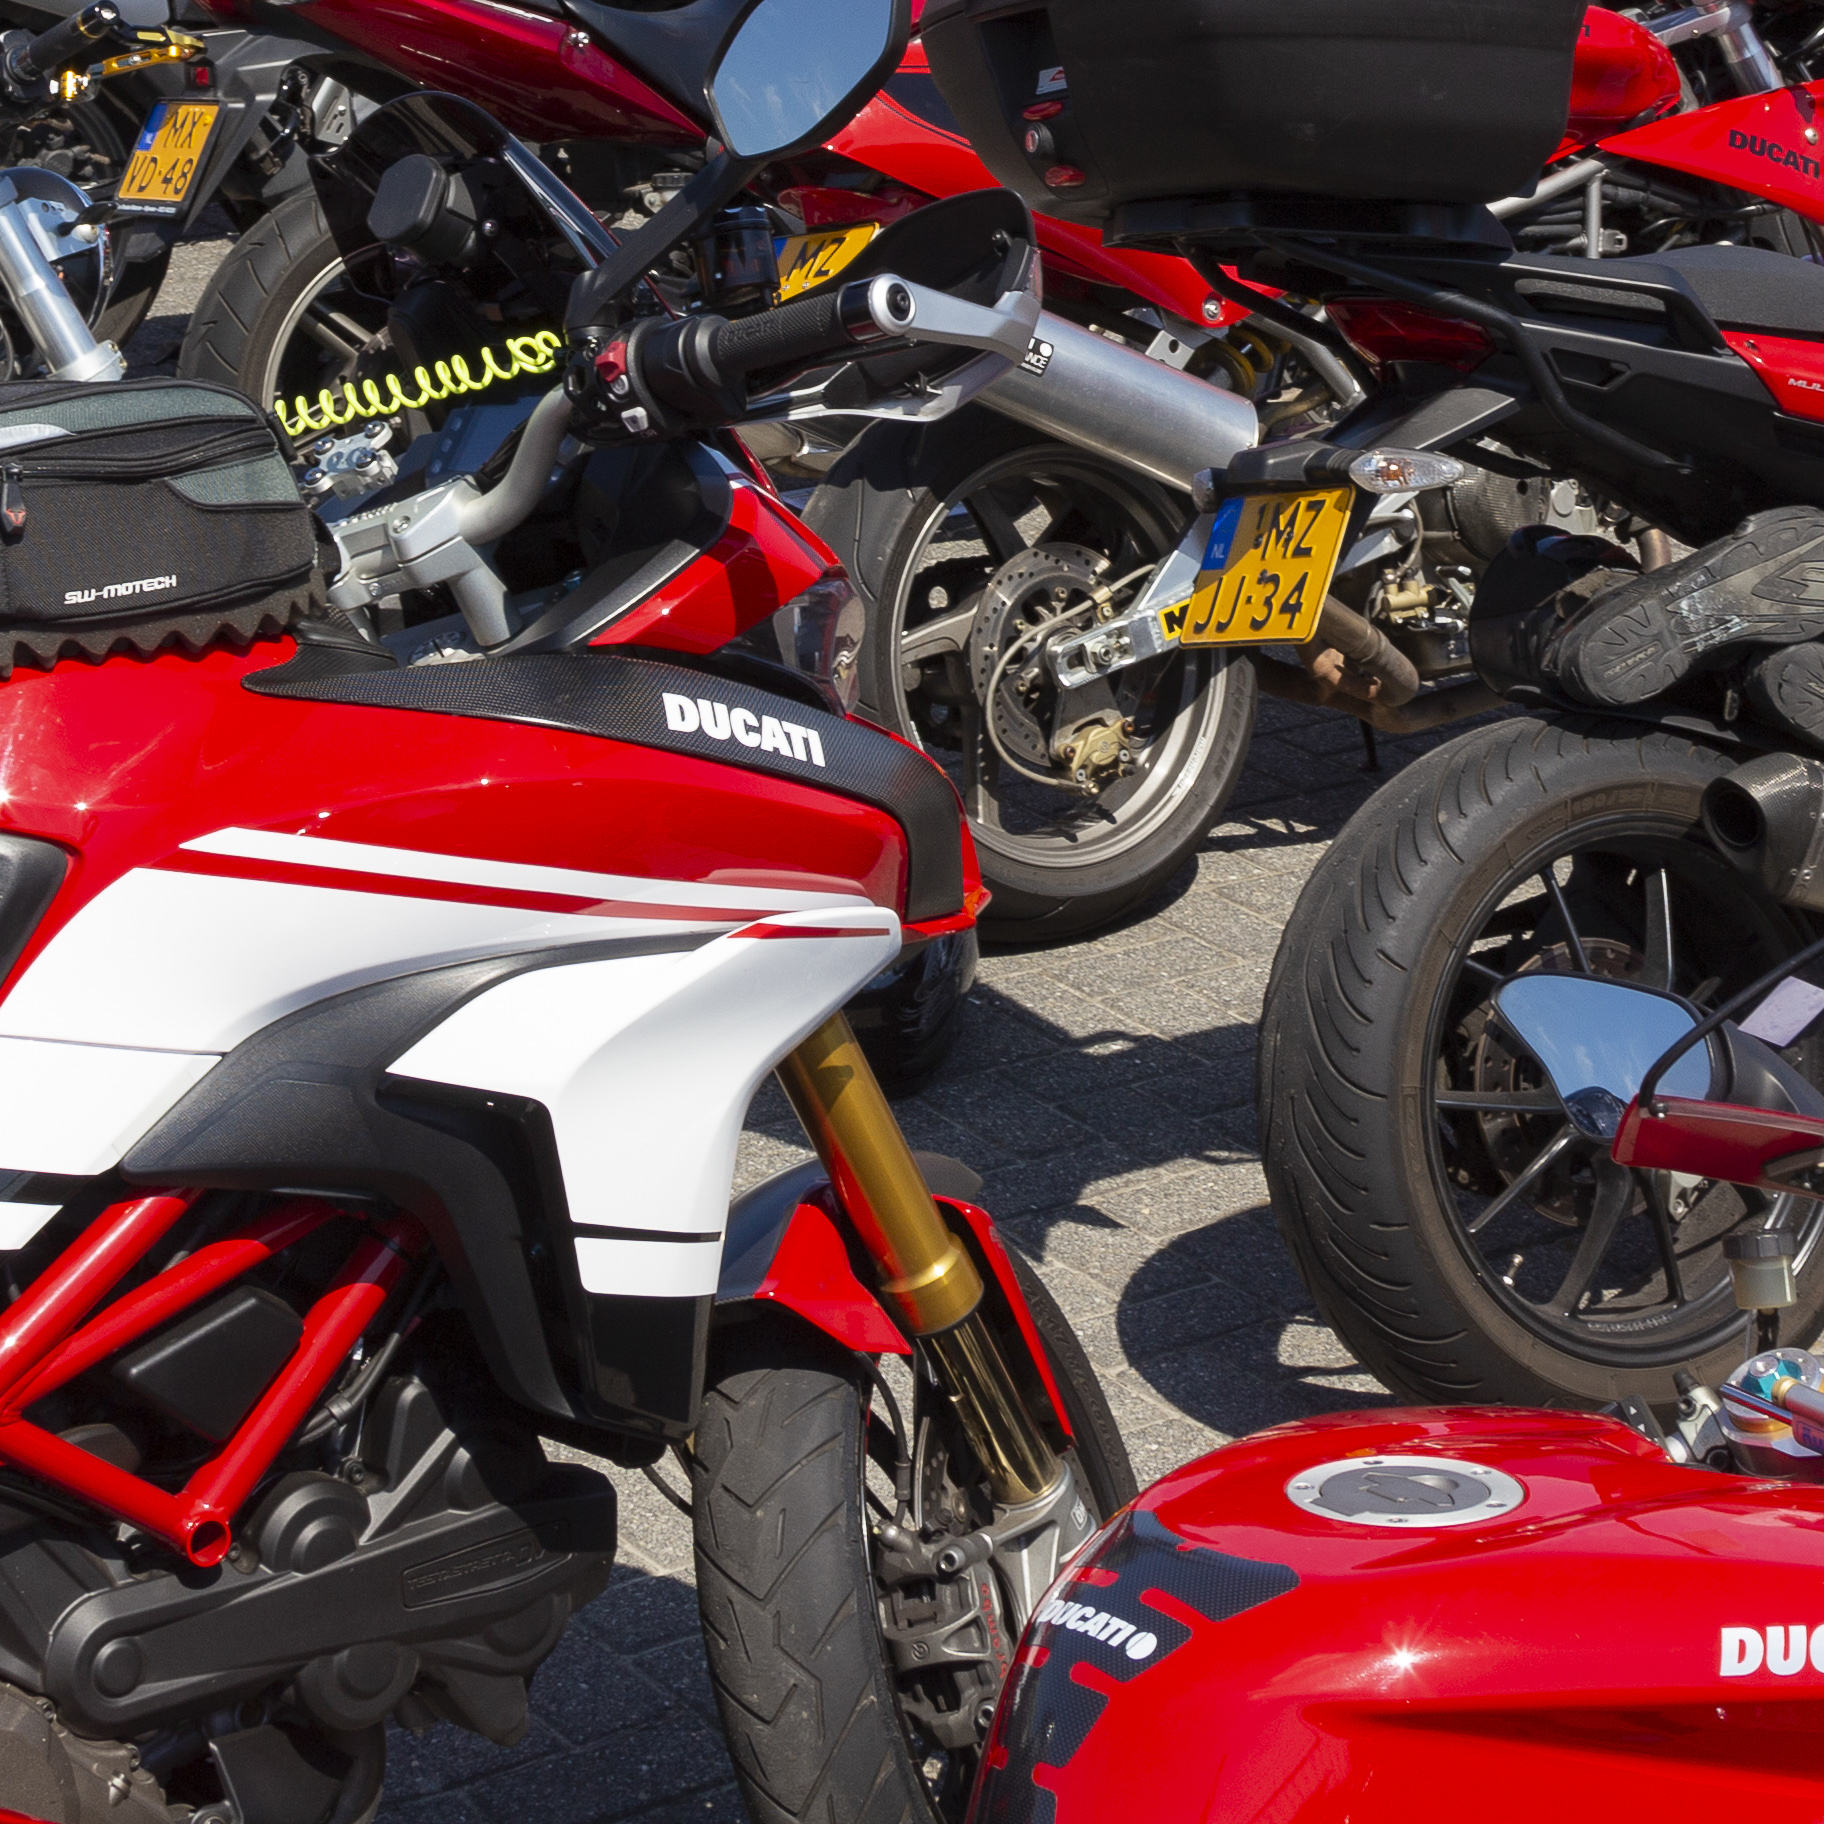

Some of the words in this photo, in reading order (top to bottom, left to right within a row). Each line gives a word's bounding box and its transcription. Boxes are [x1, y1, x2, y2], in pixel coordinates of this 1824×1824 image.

[163, 108, 204, 151] MX
[127, 152, 194, 198] VD-48
[1728, 129, 1820, 180] DUCATI
[64, 573, 177, 606] SW-MOTECH
[1193, 573, 1304, 636] JJ-34
[661, 691, 823, 766] DUCATI
[1039, 1599, 1128, 1648] DUCATI
